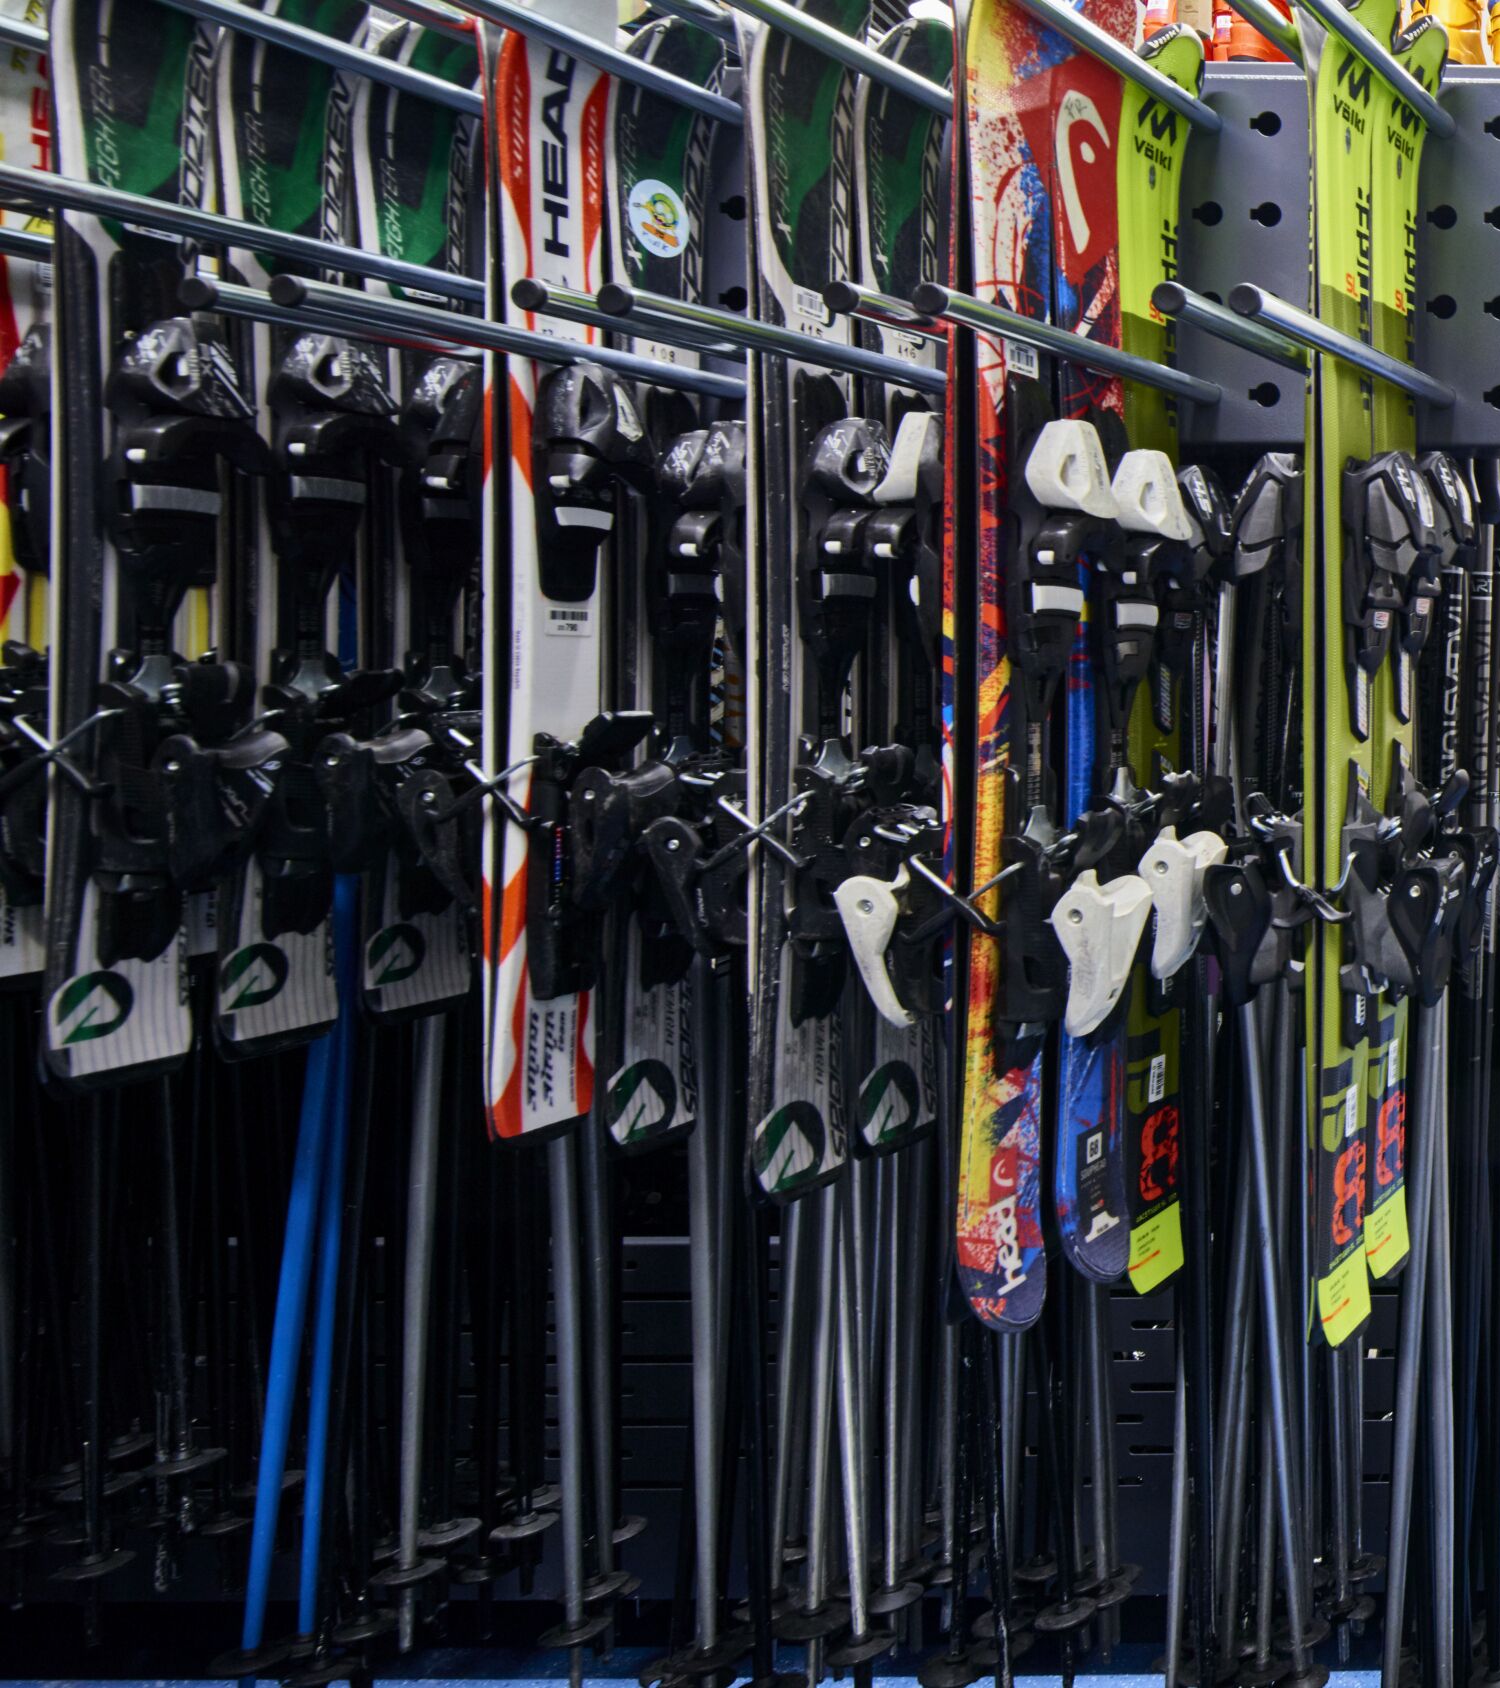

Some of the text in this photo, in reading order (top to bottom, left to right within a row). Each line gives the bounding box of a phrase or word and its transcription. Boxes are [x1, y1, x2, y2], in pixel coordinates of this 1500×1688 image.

[1333, 94, 1365, 135] Völkl
[1134, 135, 1172, 171] Völkl
[1388, 125, 1414, 162] Völkl
[988, 1194, 1028, 1296] head
